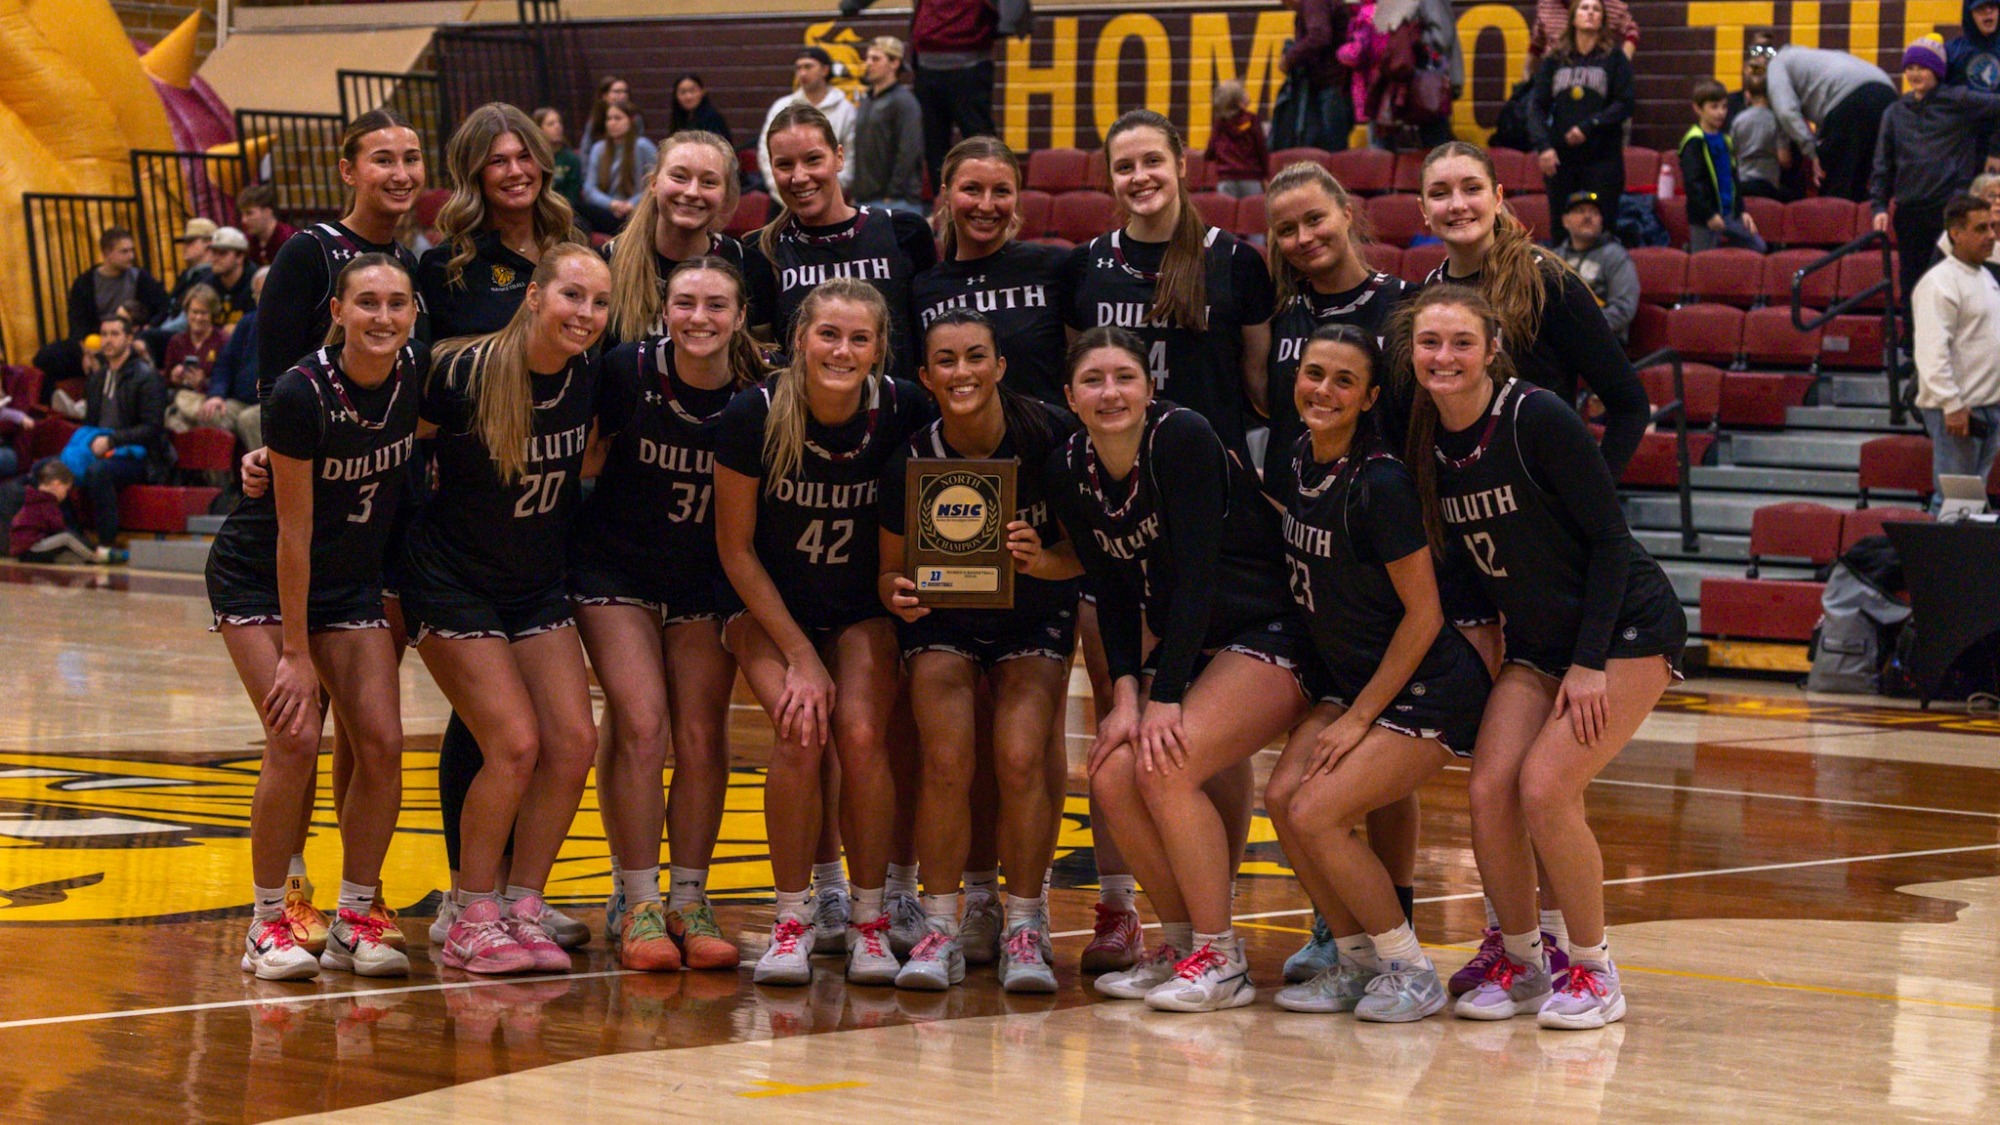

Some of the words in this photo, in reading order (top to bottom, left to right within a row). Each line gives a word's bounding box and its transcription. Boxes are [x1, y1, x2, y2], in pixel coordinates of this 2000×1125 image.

[1005, 11, 1369, 152] HOM
[782, 258, 891, 292] DULUTH
[321, 432, 413, 481] DULUTH
[489, 424, 586, 462] LUTH
[639, 438, 715, 474] DULU
[514, 470, 567, 518] 20
[668, 481, 712, 523] 31
[776, 479, 879, 509] DULUTH
[940, 474, 981, 489] NORTH
[346, 482, 380, 523] 3
[937, 503, 982, 517] NSIC
[1440, 484, 1518, 523] ULUTH
[796, 519, 855, 564] 42
[936, 539, 981, 551] CHAMPION
[1282, 510, 1333, 558] ULUTH
[1463, 532, 1508, 577] 12
[1285, 553, 1316, 613] 23
